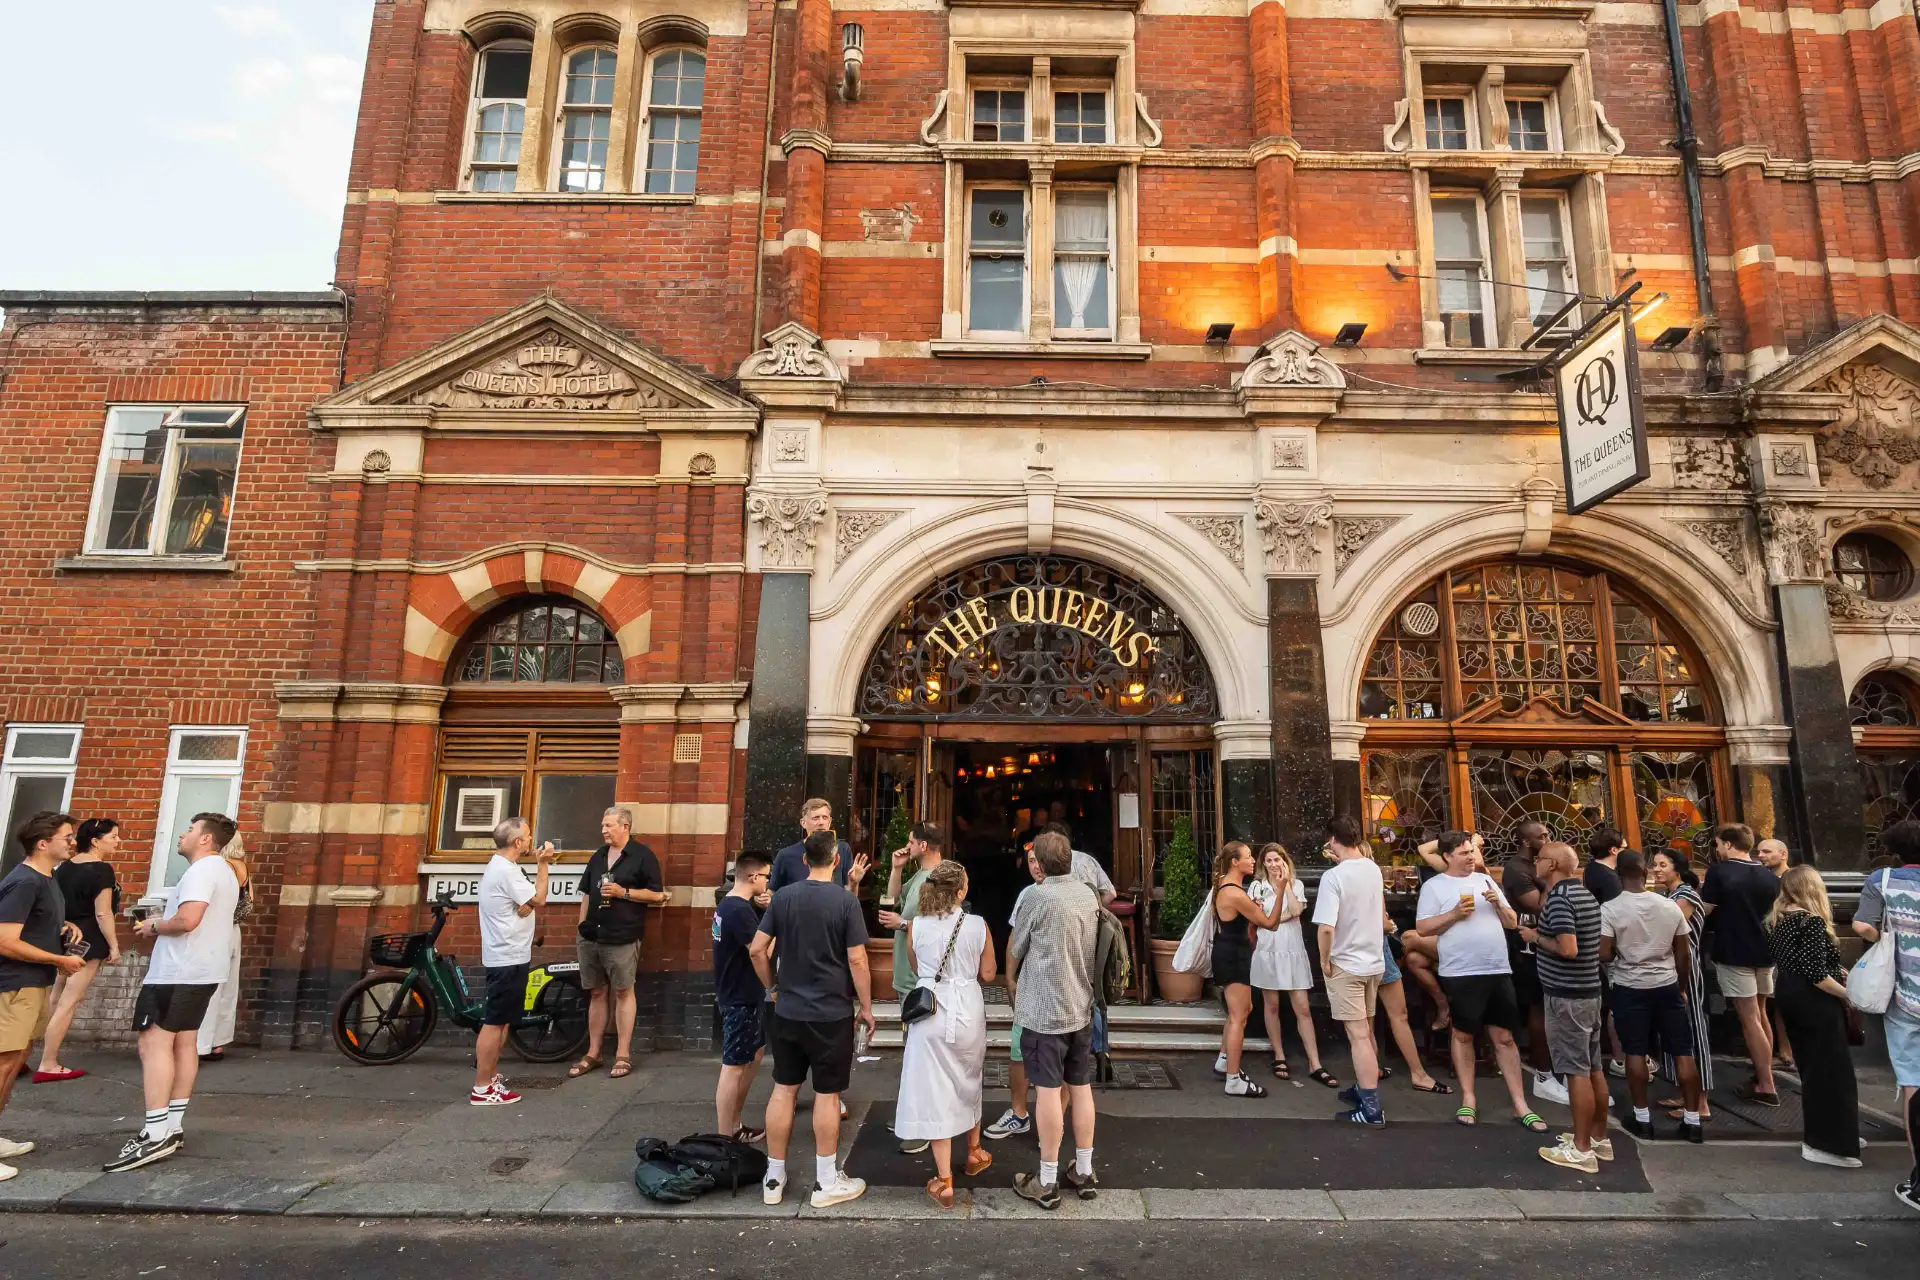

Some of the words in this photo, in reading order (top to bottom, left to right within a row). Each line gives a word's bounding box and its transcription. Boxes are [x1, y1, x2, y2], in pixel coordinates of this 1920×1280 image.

[525, 346, 569, 363] THE
[462, 370, 541, 394] QUEENS
[552, 374, 623, 394] HOTEL
[1575, 452, 1593, 474] THE
[1594, 427, 1633, 463] QUEENS
[924, 596, 997, 659] THE
[1010, 586, 1160, 667] QUEENS
[436, 881, 479, 896] ELDE
